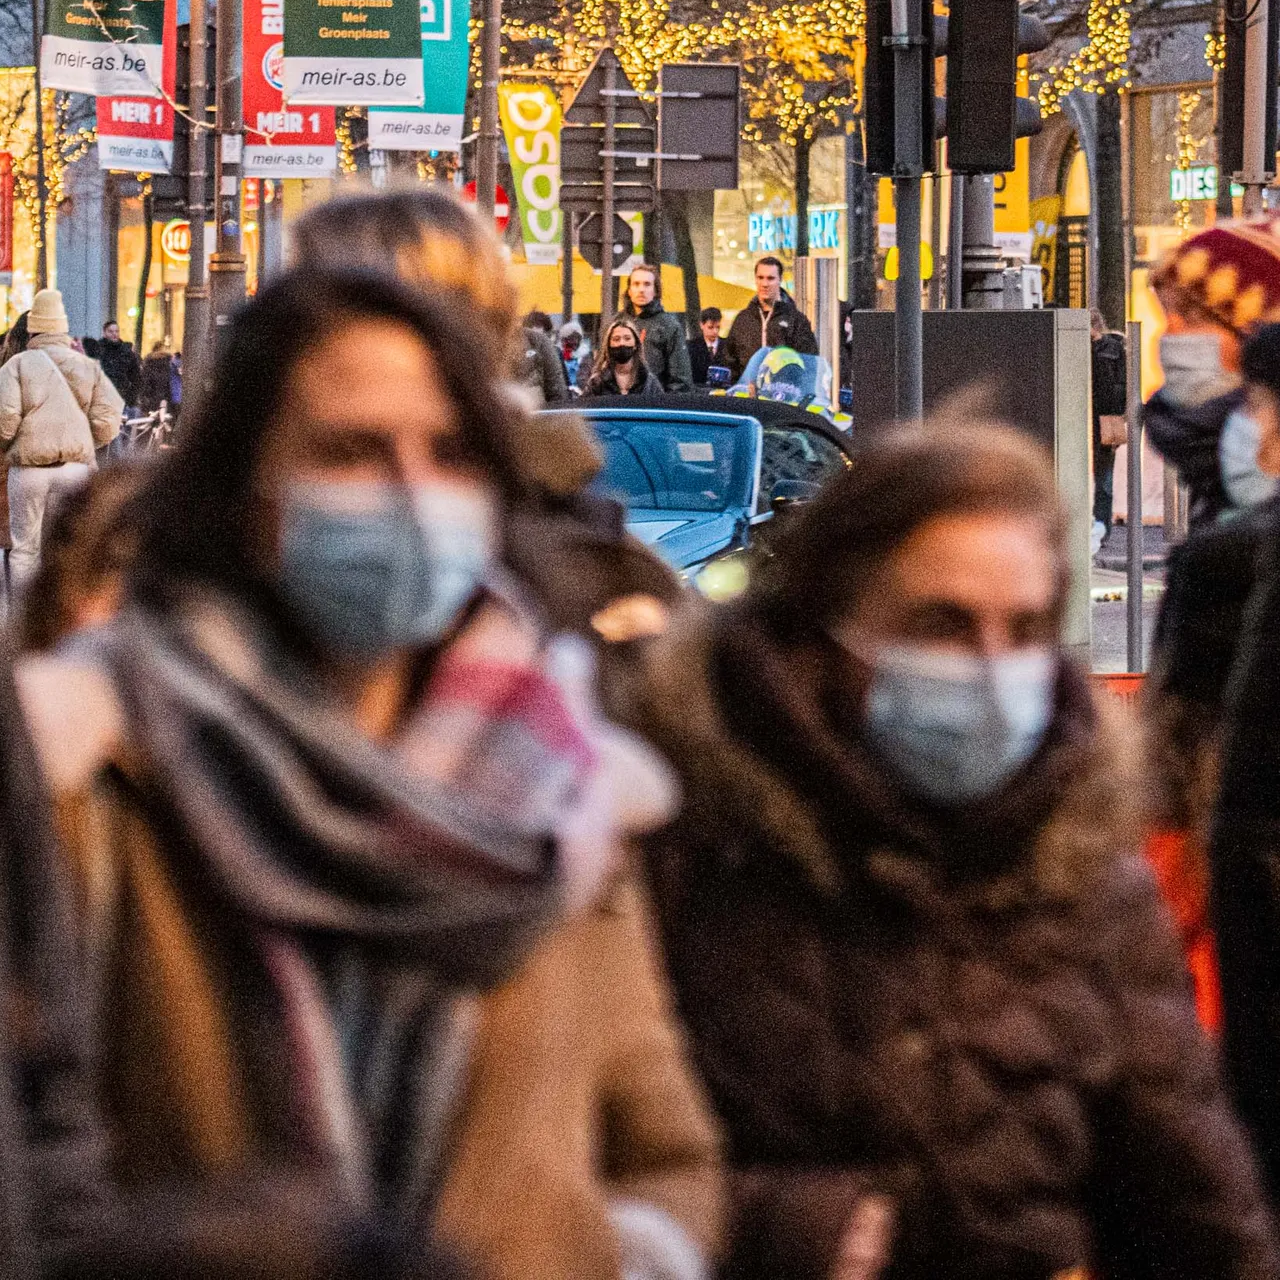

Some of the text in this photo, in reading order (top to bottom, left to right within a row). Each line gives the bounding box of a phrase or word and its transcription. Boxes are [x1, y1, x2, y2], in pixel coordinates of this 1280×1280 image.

[342, 11, 369, 23] Meir
[318, 26, 391, 41] Groenplaats
[53, 50, 147, 73] meir-as.be
[302, 68, 408, 87] meir-as.be
[111, 99, 163, 125] MEIR 1
[256, 111, 320, 133] MEIR 1
[381, 118, 451, 136] meir-as.be
[108, 142, 164, 160] meir-as.be
[252, 149, 324, 166] meir-as.be
[507, 90, 562, 243] casa
[748, 210, 839, 252] PRIMRK
